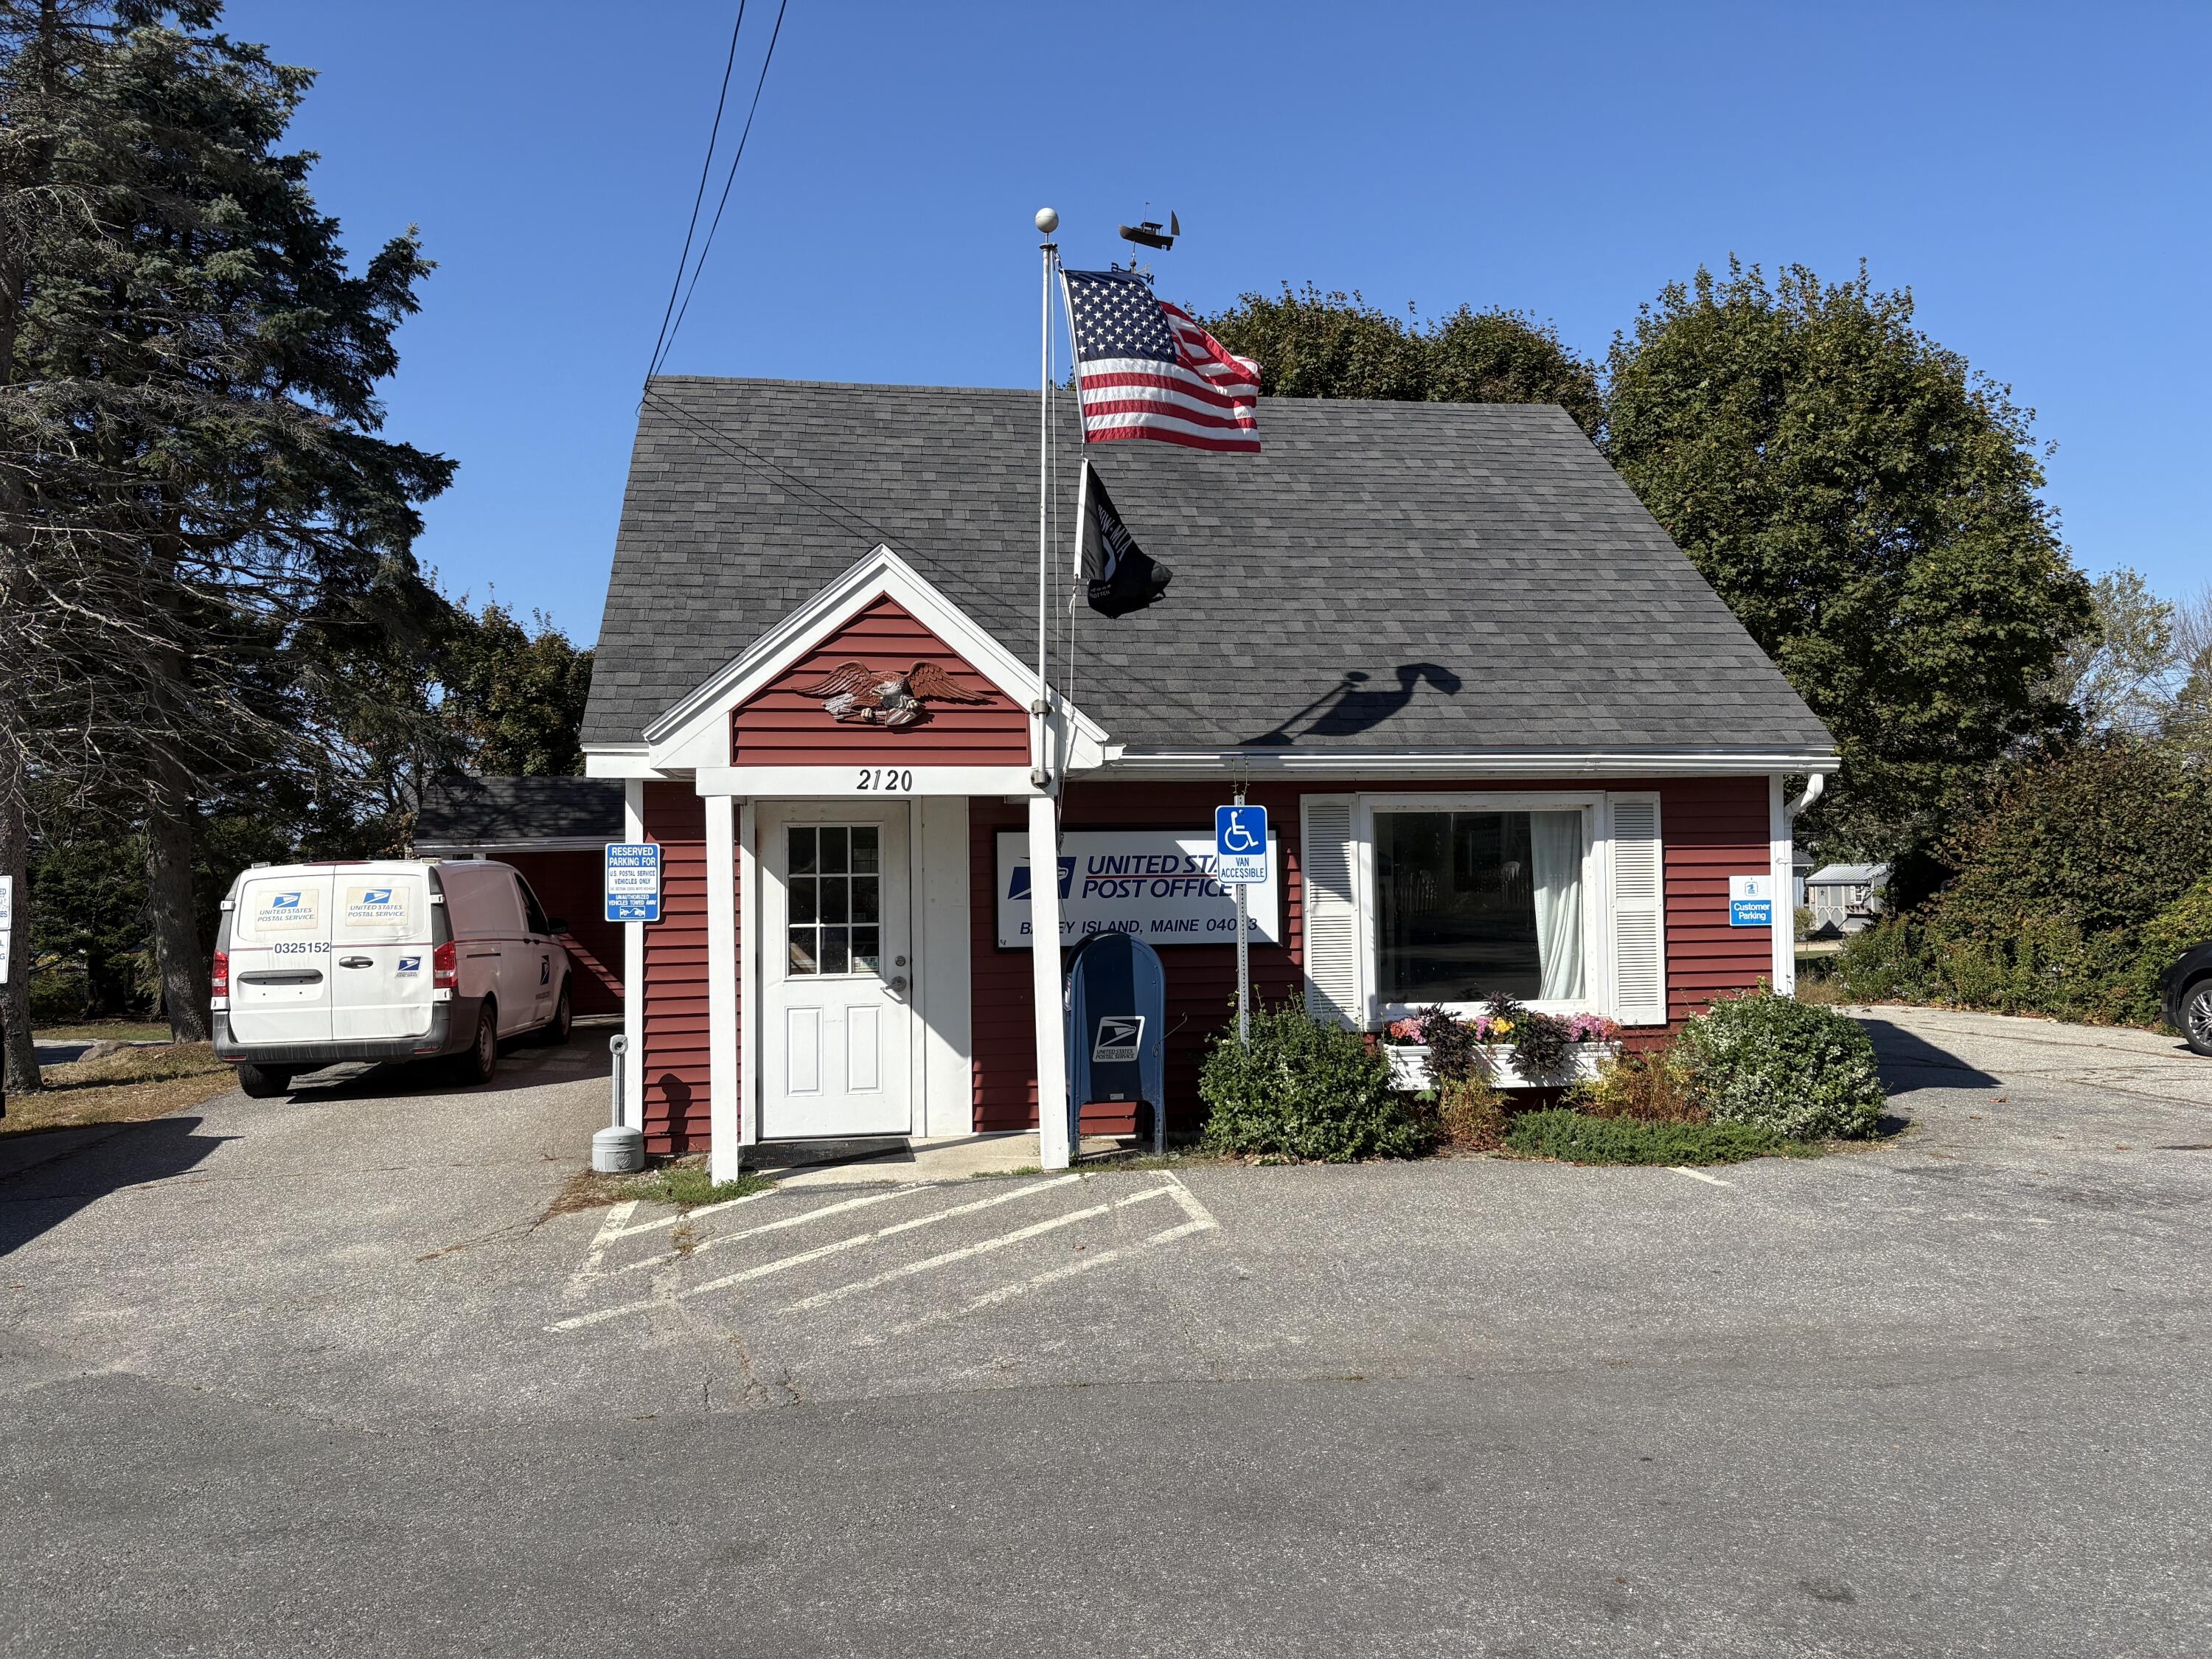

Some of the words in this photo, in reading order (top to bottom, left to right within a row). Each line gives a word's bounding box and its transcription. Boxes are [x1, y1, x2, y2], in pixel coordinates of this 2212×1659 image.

[1110, 524, 1133, 562] MIA
[856, 769, 913, 792] 2120
[611, 846, 654, 856] RESERVED
[609, 857, 639, 866] PARKING
[641, 857, 655, 866] FOR
[1087, 855, 1179, 874] UNITED
[1235, 857, 1249, 866] VAN
[1221, 868, 1265, 877] ACCESSIBLE
[1082, 879, 1147, 899] POST
[1150, 878, 1232, 897] OFFICE
[1733, 902, 1770, 911] Customer
[1738, 912, 1767, 921] Parking
[1020, 921, 1076, 935] BEY
[1081, 919, 1144, 936] ISLAND,
[1150, 919, 1200, 933] MAINE
[1206, 918, 1258, 932] 0403
[274, 942, 330, 953] 0325152
